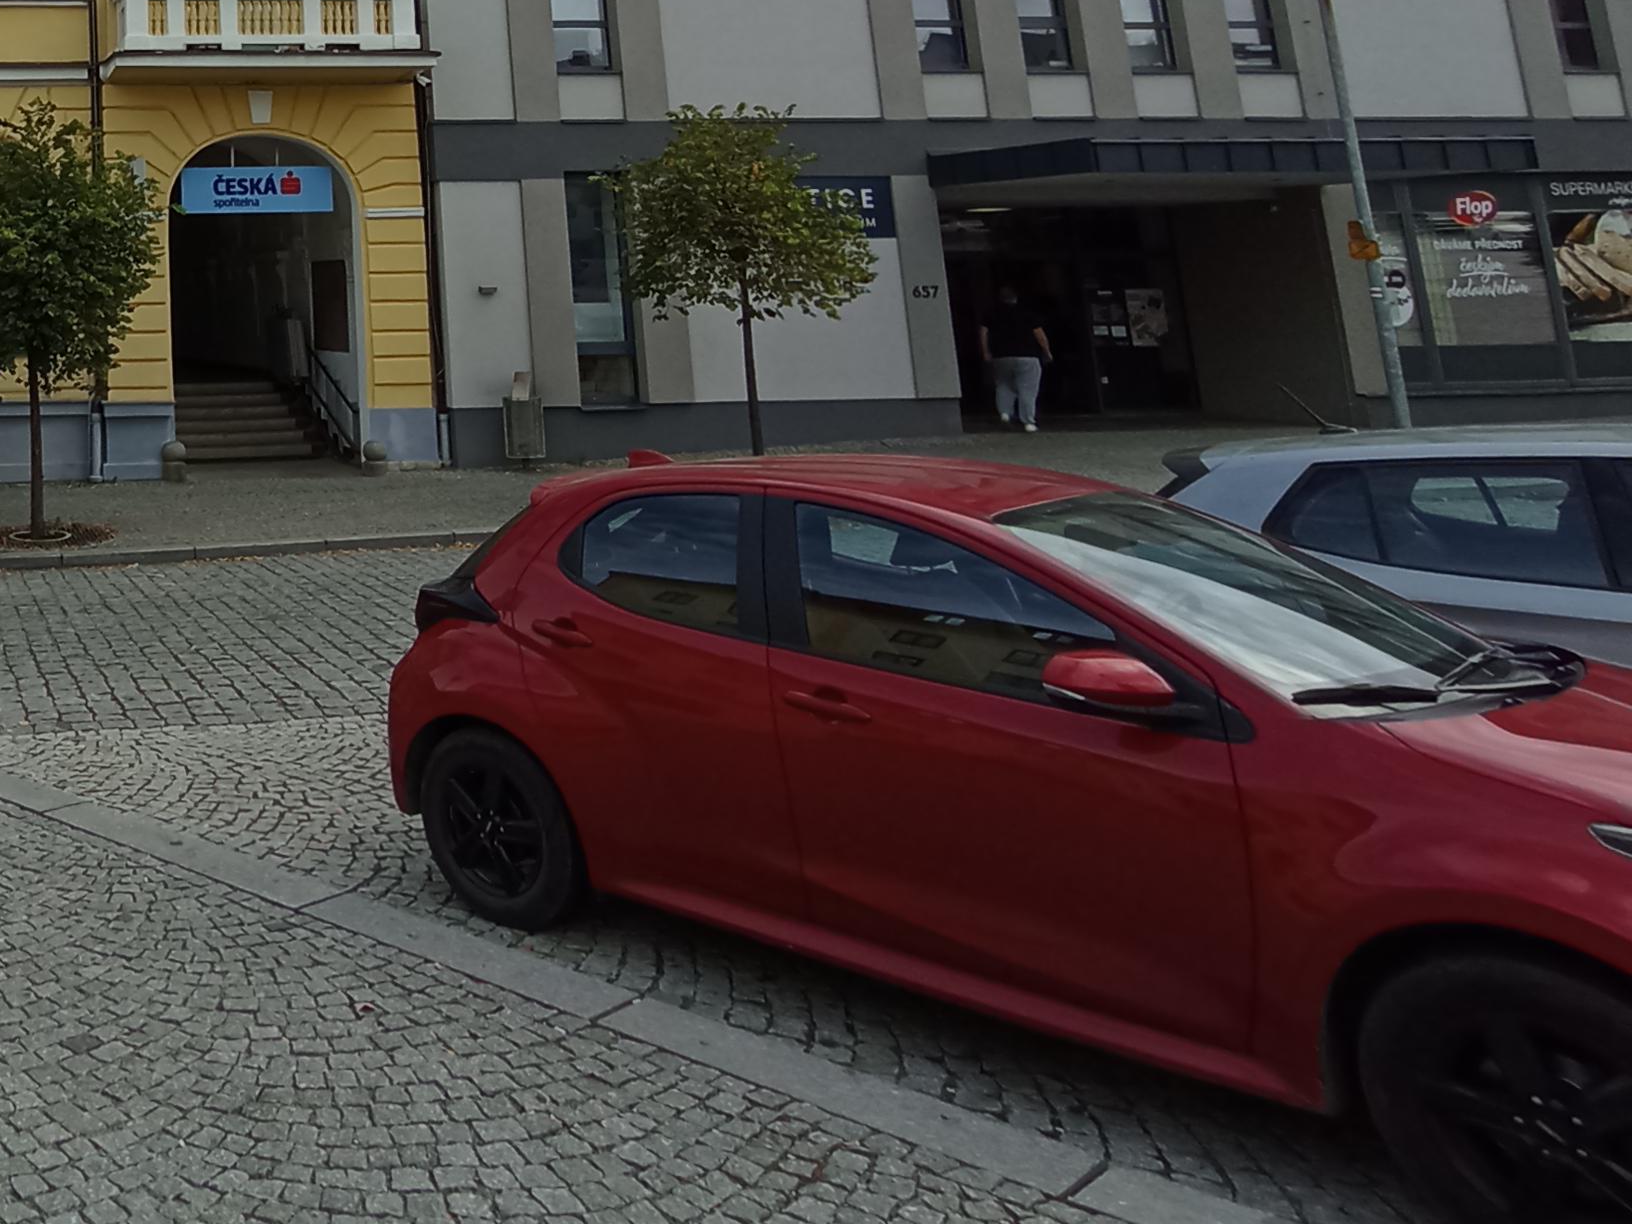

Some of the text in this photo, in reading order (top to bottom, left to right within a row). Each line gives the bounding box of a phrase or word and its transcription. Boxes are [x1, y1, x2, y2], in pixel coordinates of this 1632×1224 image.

[213, 173, 277, 195] ČESKÁ
[214, 197, 260, 209] spořitelna
[1455, 196, 1493, 217] Flop
[912, 285, 939, 299] 657
